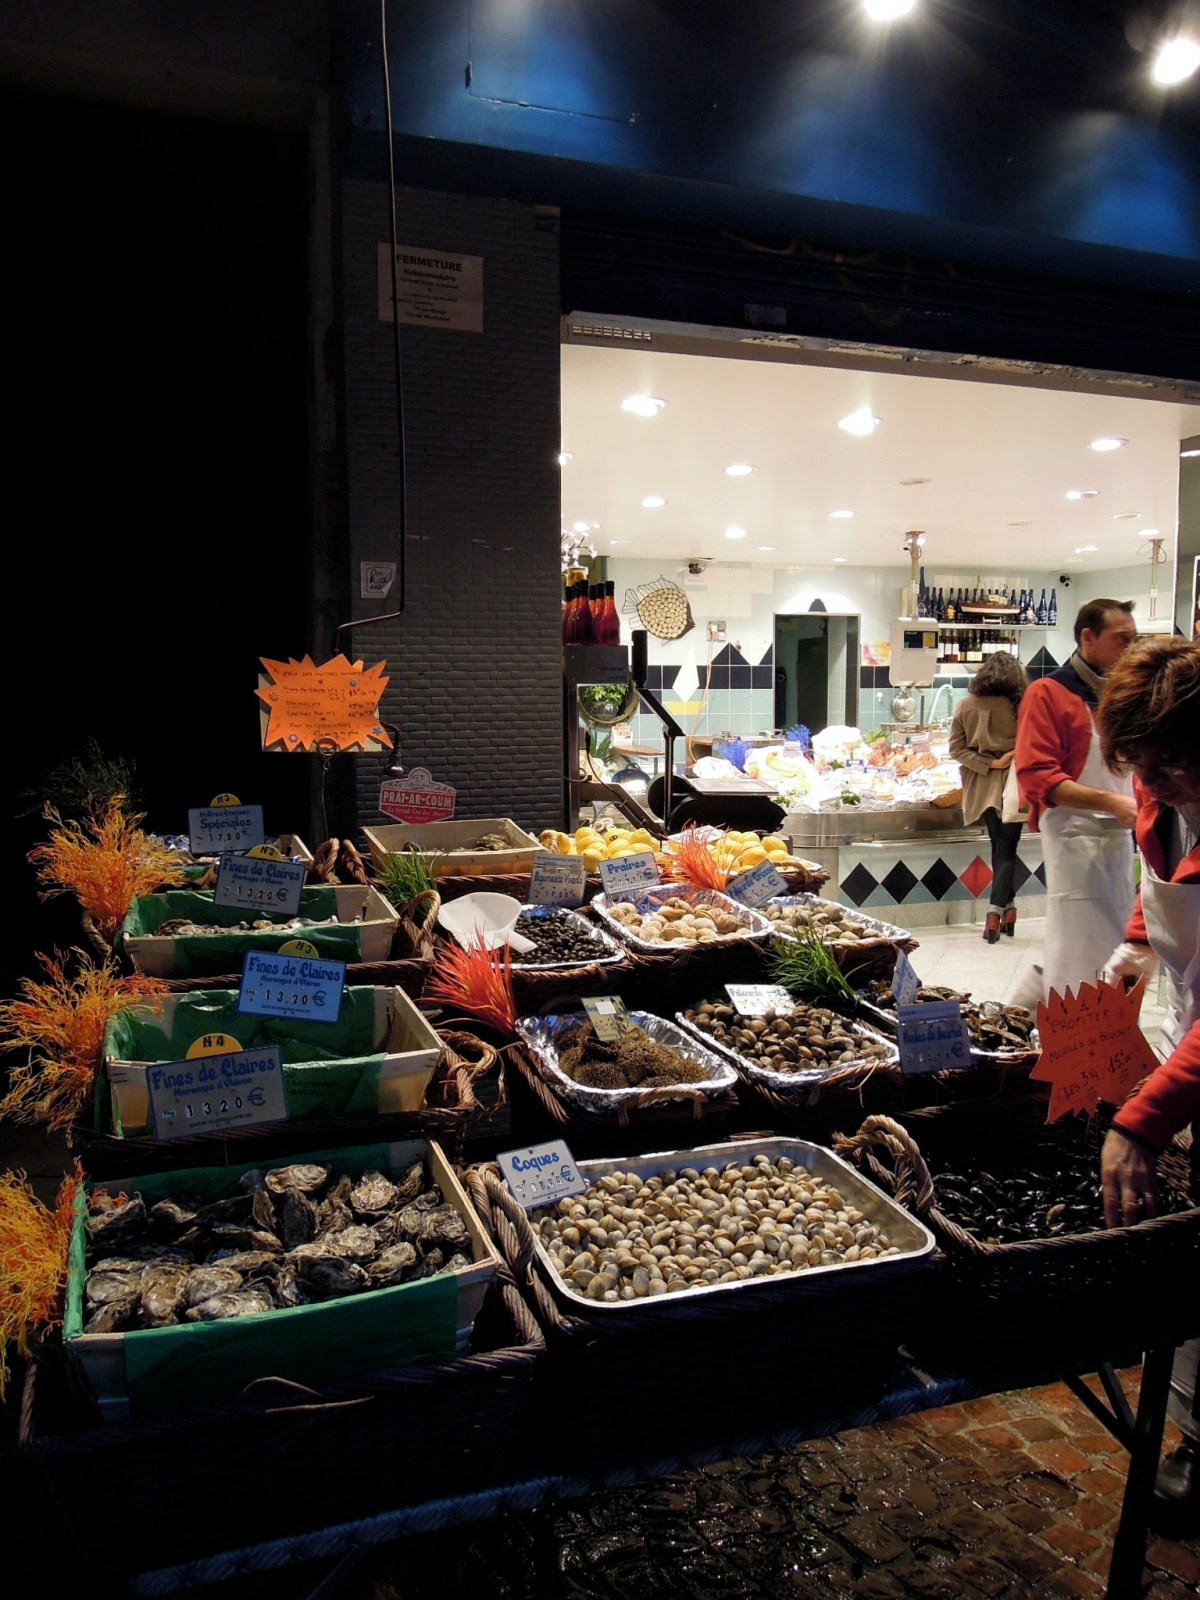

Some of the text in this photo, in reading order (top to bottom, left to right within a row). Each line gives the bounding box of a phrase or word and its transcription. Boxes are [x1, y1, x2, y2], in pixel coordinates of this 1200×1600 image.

[396, 254, 462, 272] FERMETURE
[383, 791, 452, 808] PRAT-AR-COUM
[200, 817, 252, 832] Spéciales
[222, 858, 301, 881] Fines de Claires
[606, 861, 647, 874] Praires
[248, 956, 341, 981] Fines de Claires
[1050, 1008, 1110, 1032] PROFITER
[151, 1058, 276, 1090] Fines de Claires
[511, 1151, 560, 1172] Coques
